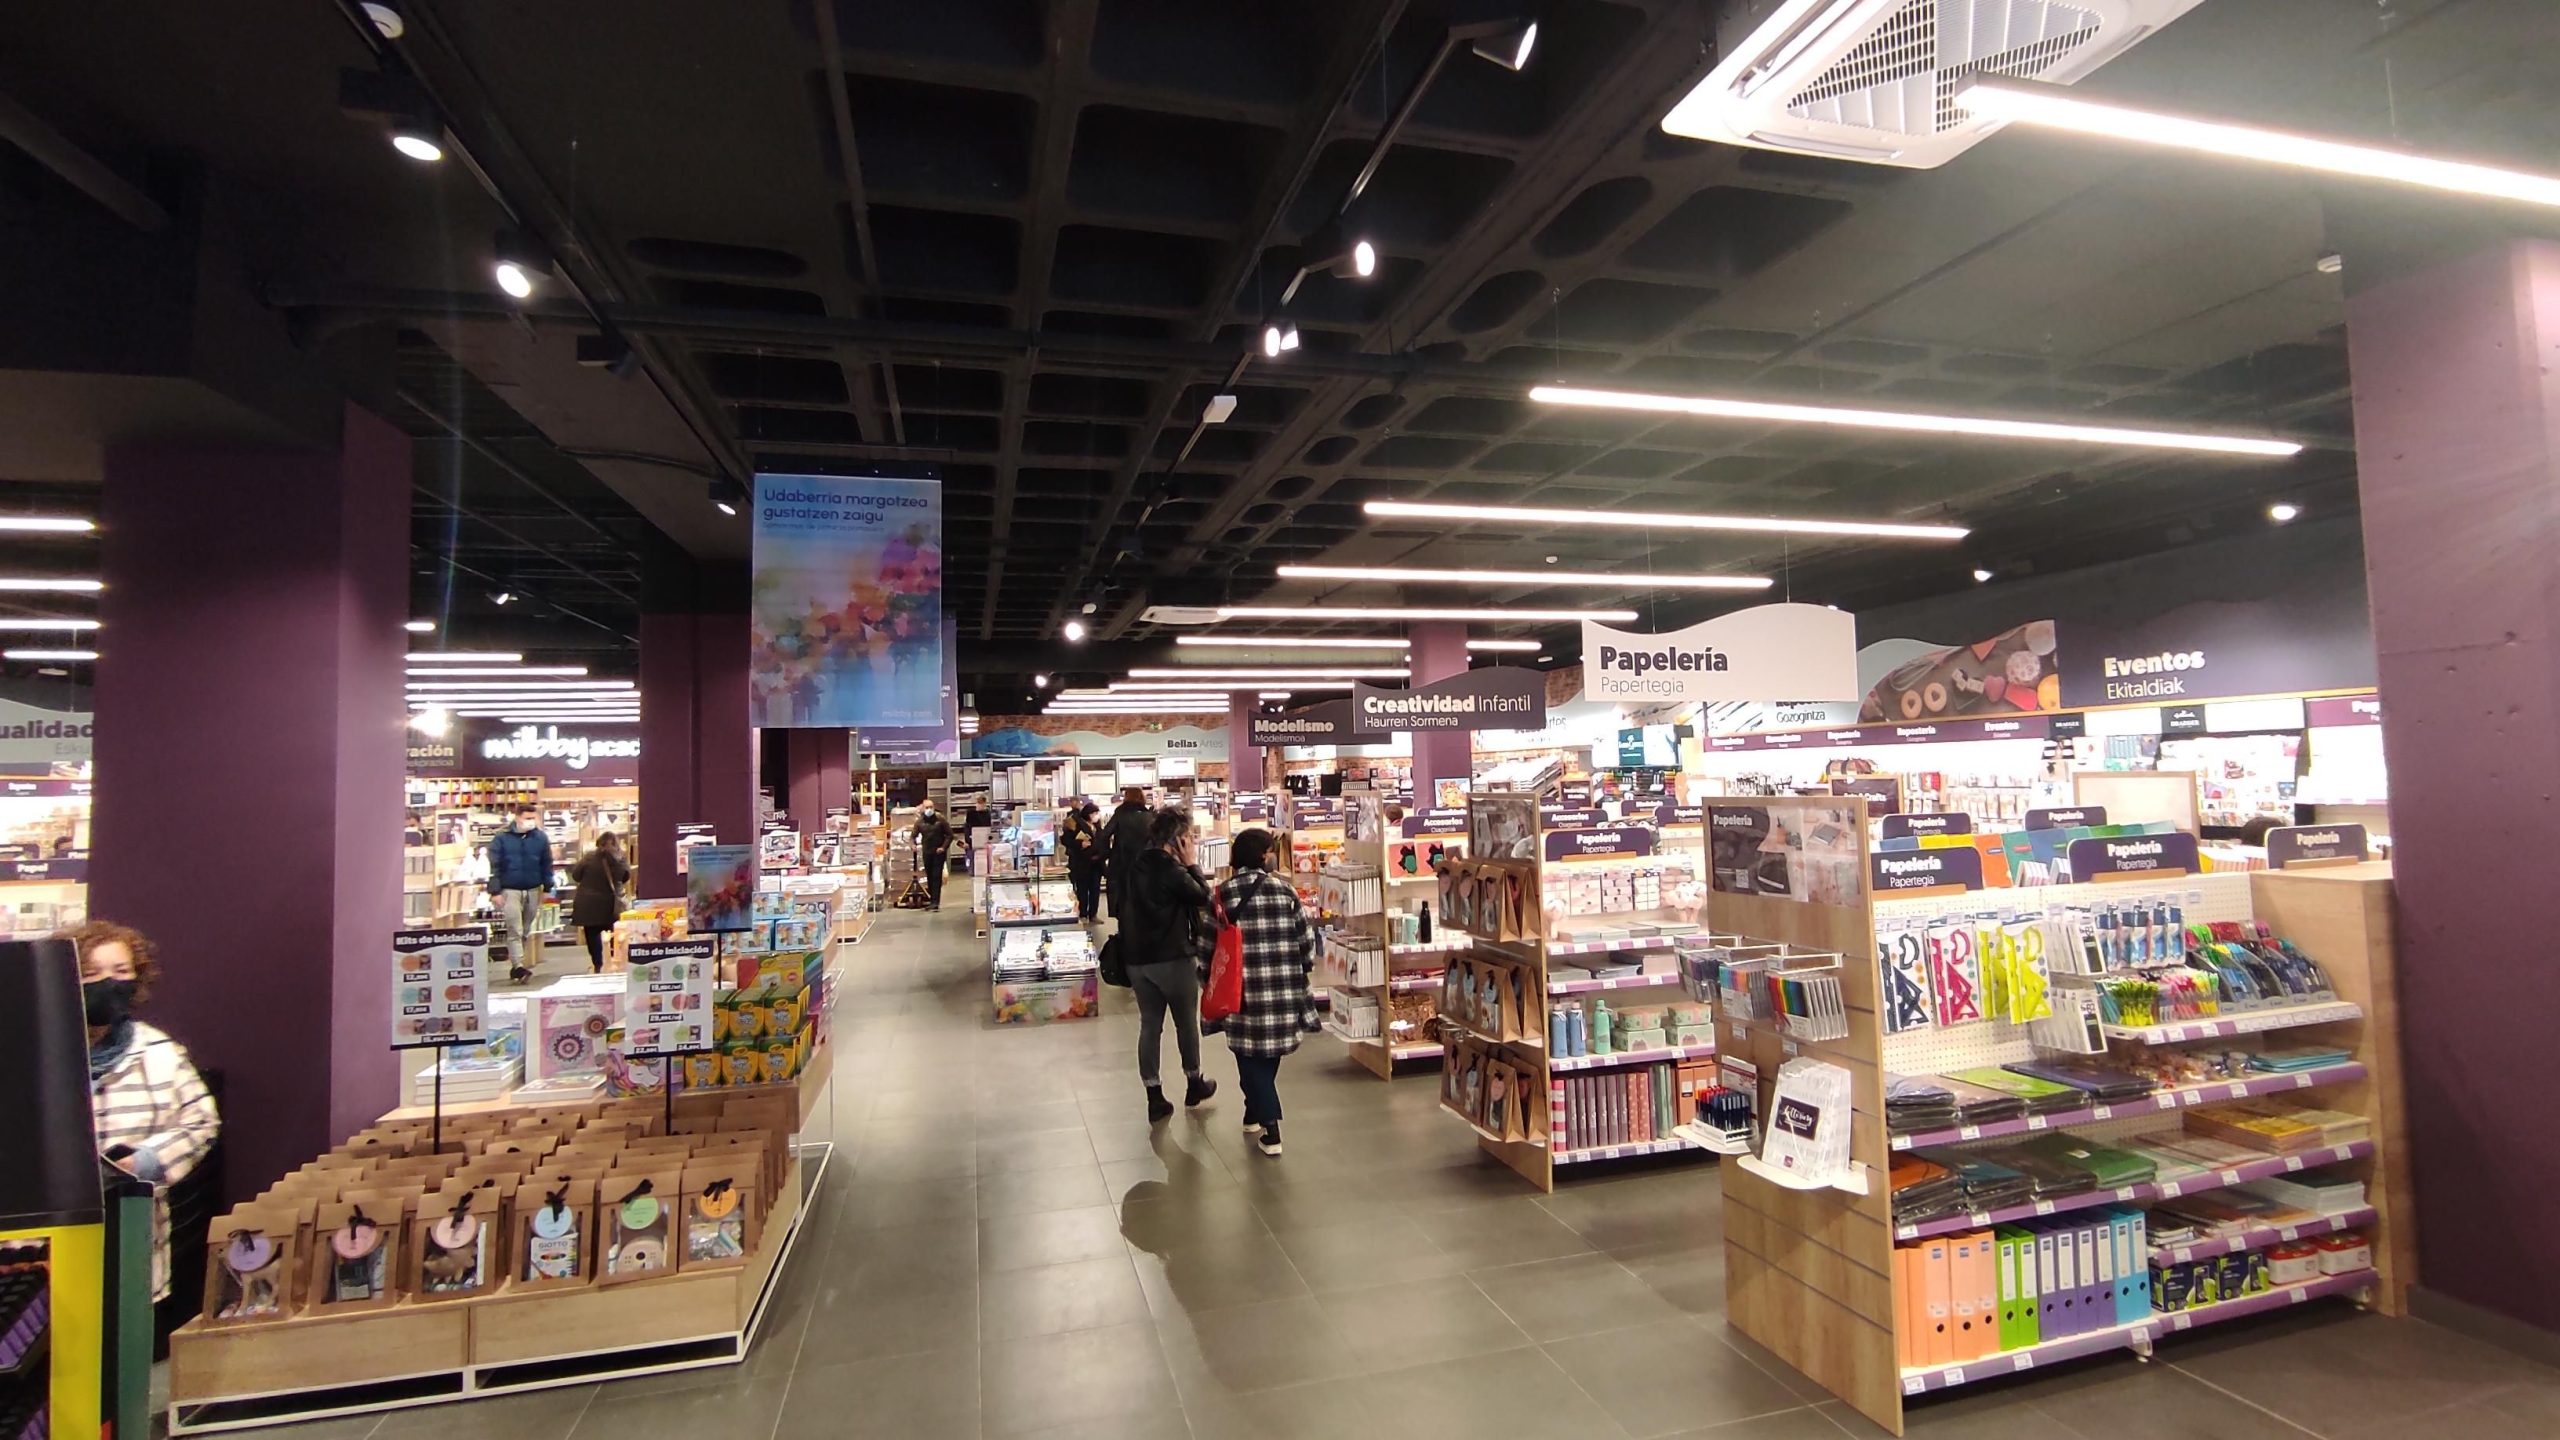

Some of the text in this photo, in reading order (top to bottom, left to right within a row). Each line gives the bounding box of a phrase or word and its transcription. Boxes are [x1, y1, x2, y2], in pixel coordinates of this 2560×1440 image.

[764, 489, 928, 508] Udaberria margotzea
[763, 506, 884, 524] gustatzen zaigu
[1600, 646, 1728, 676] Papelería
[2104, 650, 2206, 677] Eventos
[1601, 677, 1684, 696] Papertegia
[2107, 677, 2186, 700] Ekitaldiak
[1363, 694, 1531, 713] Creatividad Infantil
[1364, 716, 1459, 727] Haurren Sormena
[1776, 711, 1826, 724] Gozogintza
[1254, 719, 1335, 732] Modelismo
[1167, 740, 1224, 748] Bellas Artes
[1255, 734, 1306, 742] Modelismoa
[1424, 817, 1463, 826] Accesorios
[1713, 814, 1753, 828] Papelería
[1908, 817, 1946, 828] Papelería
[2048, 811, 2084, 822] Papelería
[1576, 832, 1621, 845] Papelería
[2296, 831, 2340, 847] Papelería
[1582, 845, 1616, 853] Papertegia
[2107, 840, 2163, 858] Papelería
[1880, 856, 1942, 875] Papelería
[2116, 858, 2158, 870] Papertegia
[1890, 875, 1935, 888] Papertegia
[396, 936, 418, 945] Kits
[631, 948, 649, 956] Kits
[538, 1241, 568, 1249] GIOTTO
